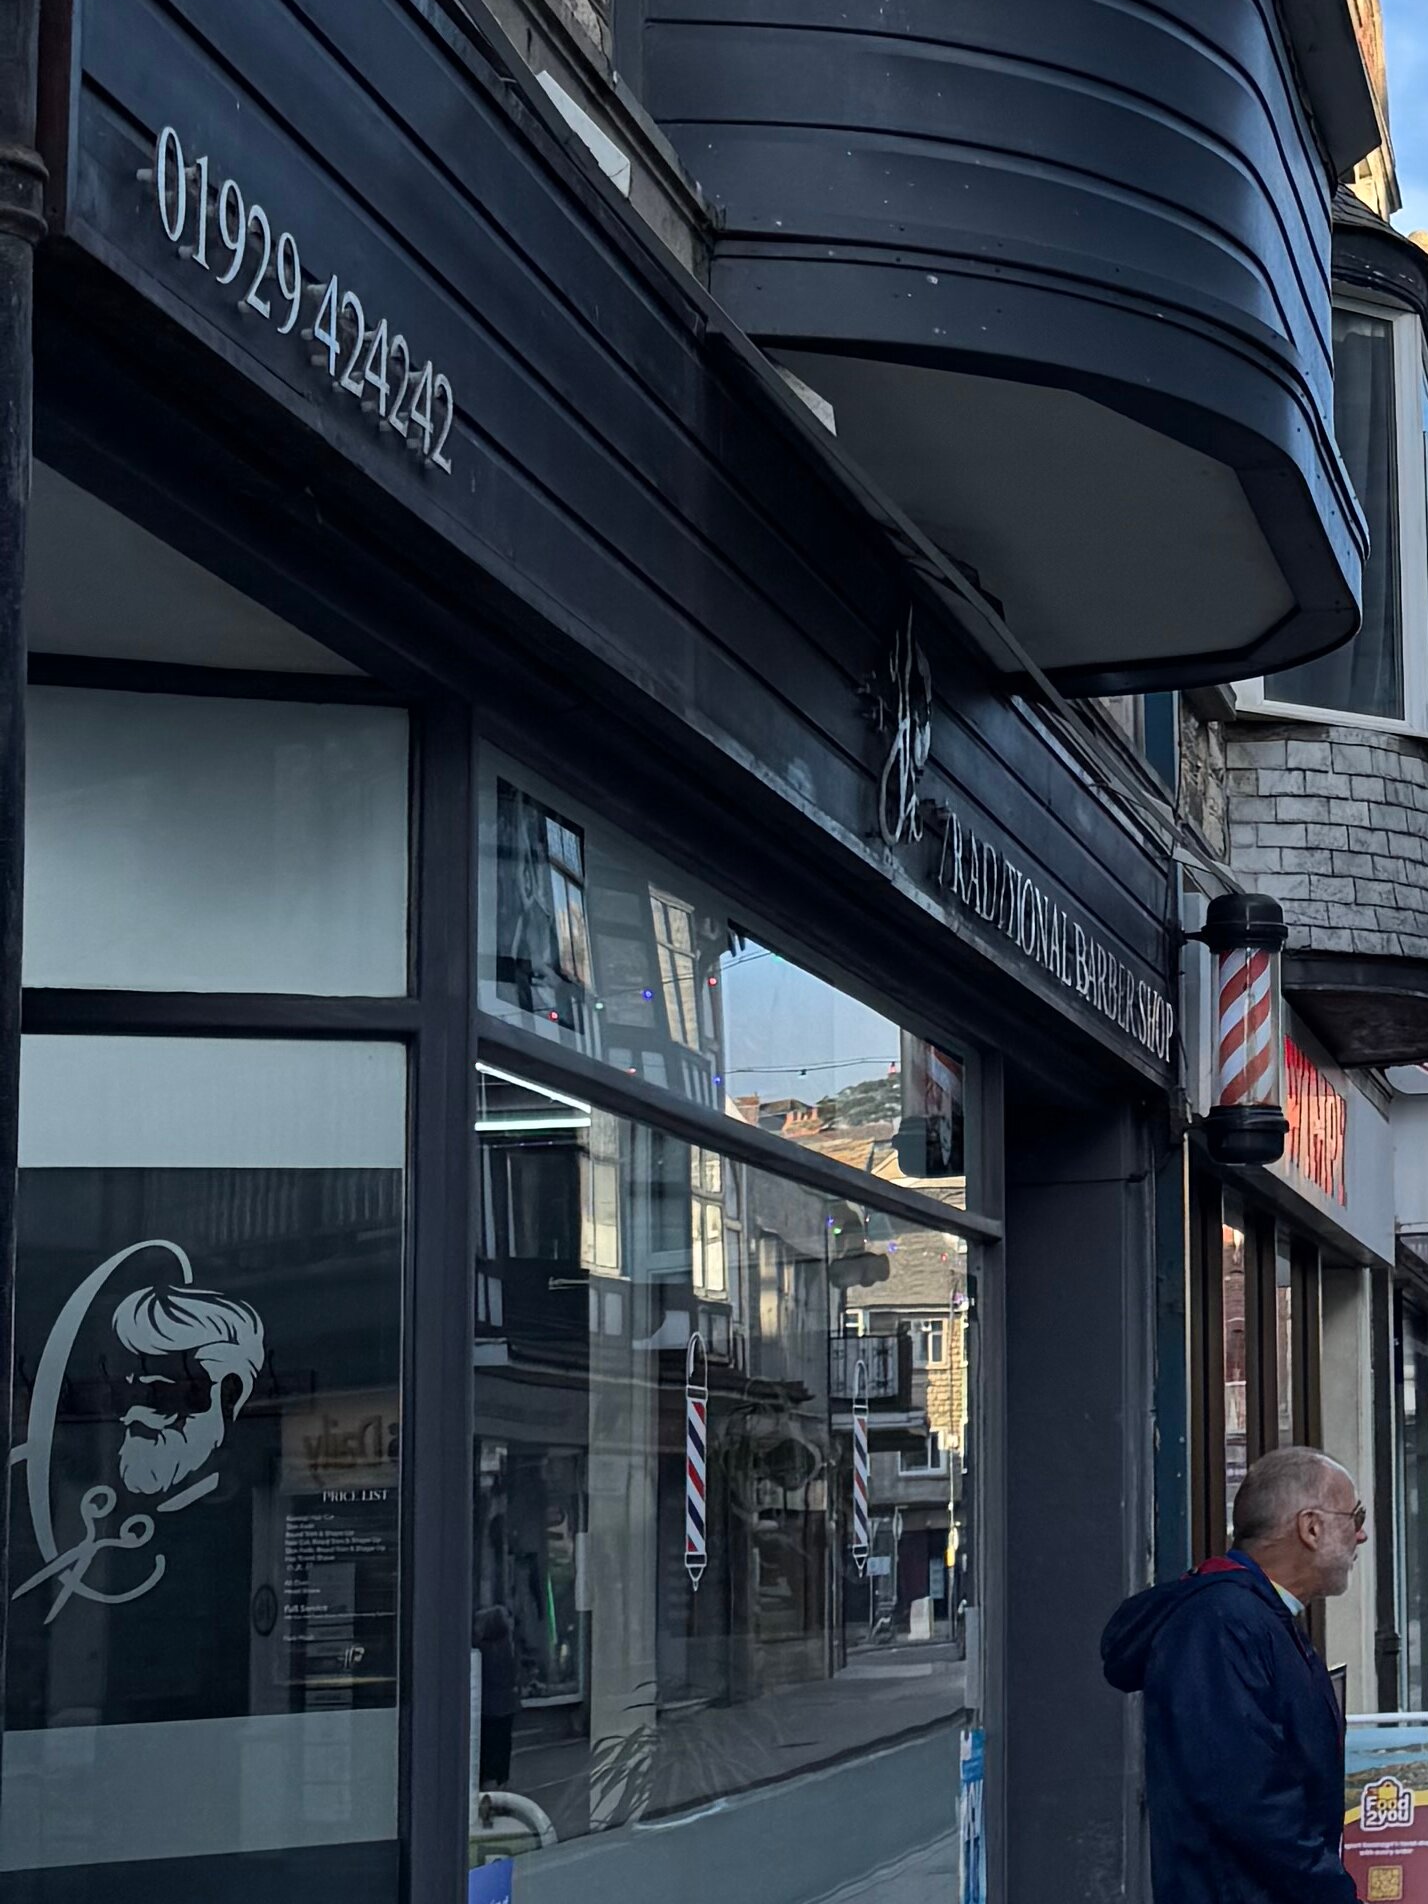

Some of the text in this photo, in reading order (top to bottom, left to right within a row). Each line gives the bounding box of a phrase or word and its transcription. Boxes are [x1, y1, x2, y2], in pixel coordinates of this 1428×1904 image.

[157, 126, 453, 475] 01929 424242
[938, 799, 1174, 1063] TRADITIONAL BARBER SHOP
[361, 1489, 389, 1501] LIST
[1366, 1794, 1409, 1811] Food
[1366, 1809, 1409, 1826] 2you
